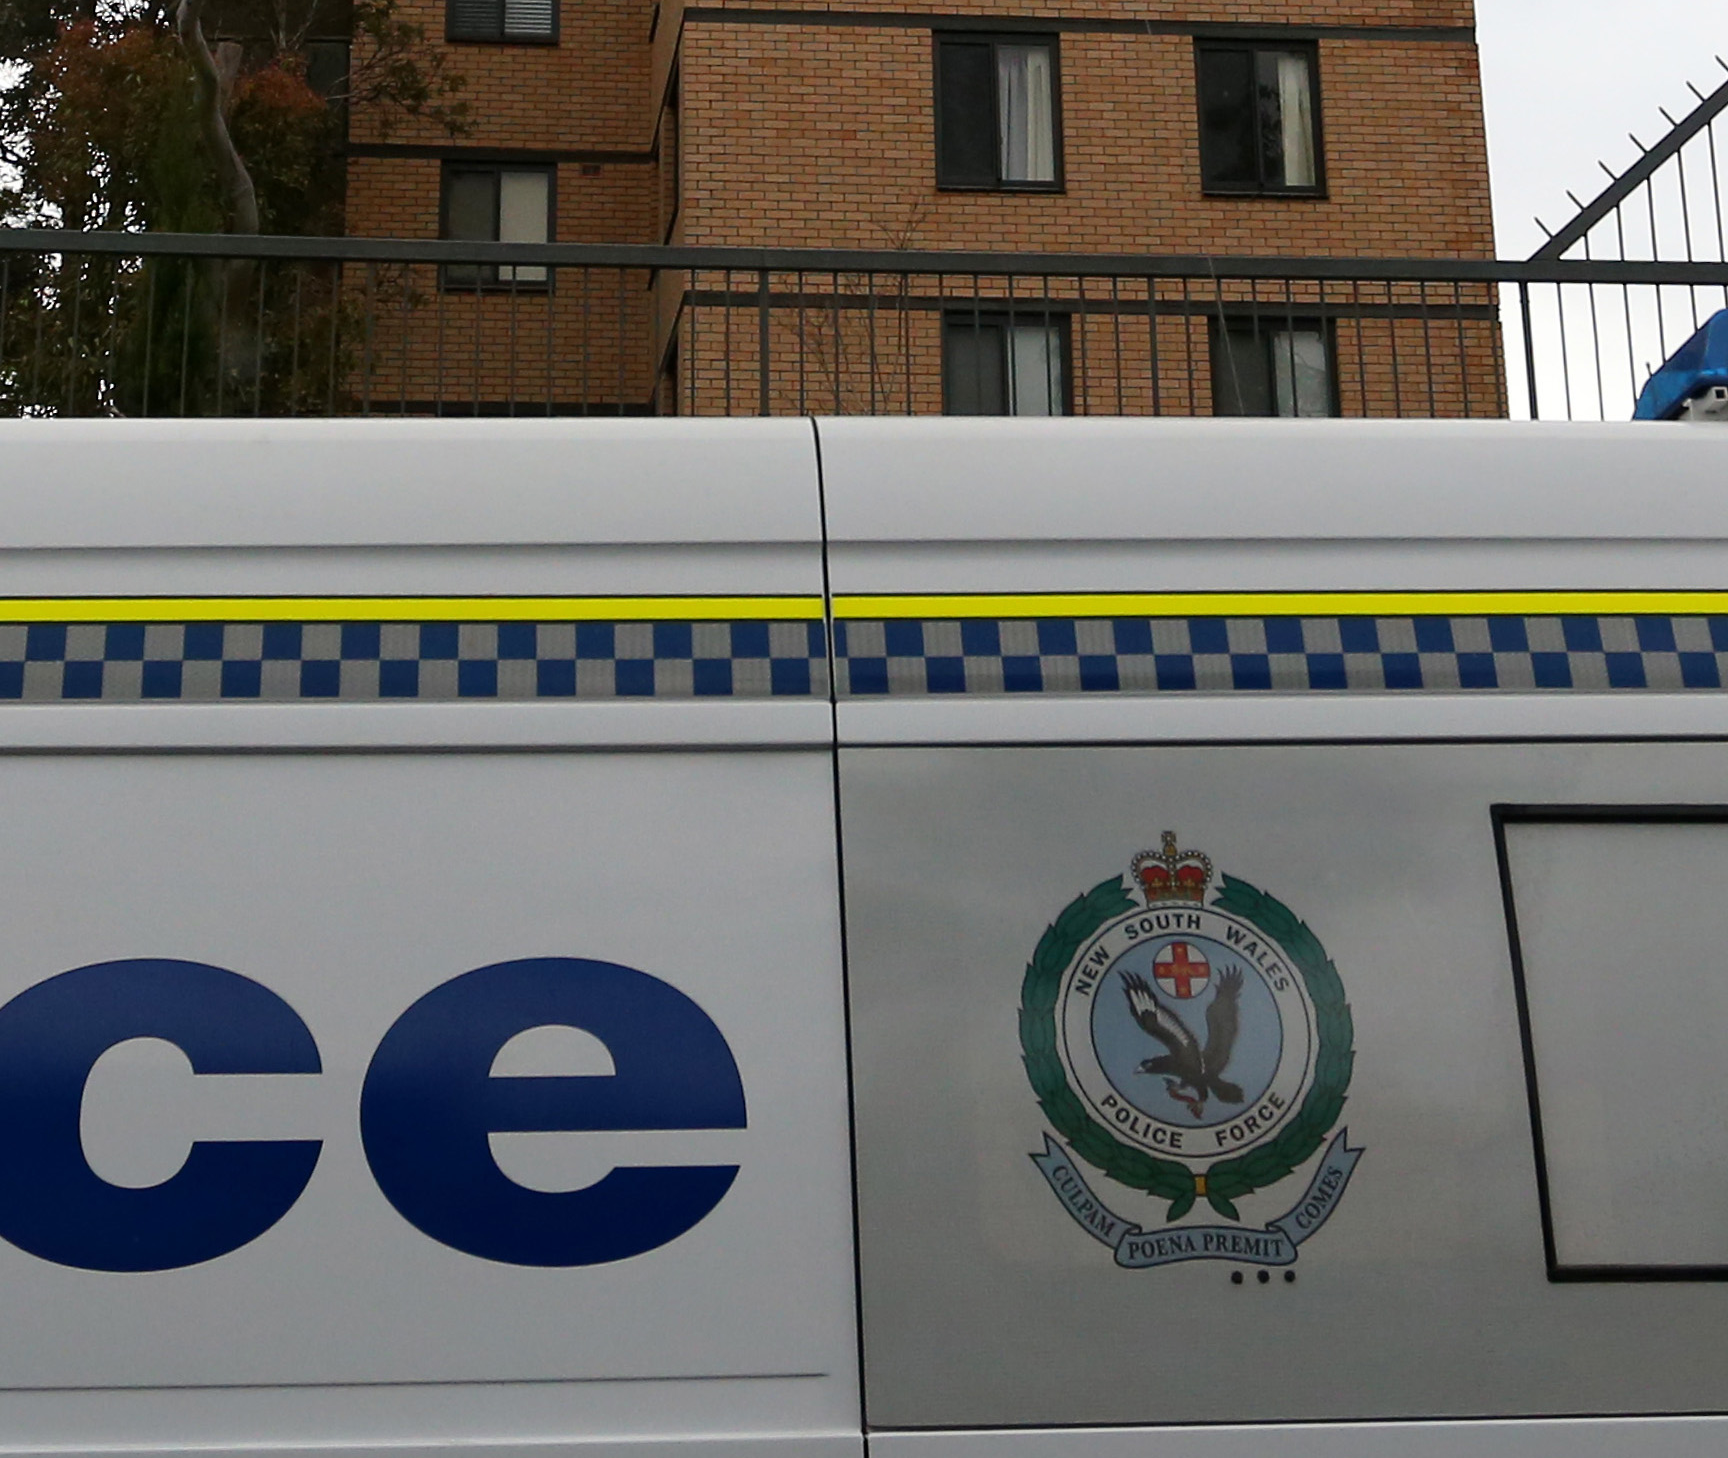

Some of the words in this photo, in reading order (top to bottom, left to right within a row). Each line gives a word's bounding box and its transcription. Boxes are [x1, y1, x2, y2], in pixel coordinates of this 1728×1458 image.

[1075, 945, 1111, 996] NEW
[1125, 913, 1202, 940] SOUTH
[1225, 925, 1290, 992] WALES
[1100, 1094, 1183, 1148] POLICE
[1215, 1092, 1285, 1146] FORCE
[1052, 1165, 1115, 1237] CULPAM
[1128, 1236, 1196, 1259] POENA
[1203, 1233, 1284, 1257] PREMIT
[1295, 1165, 1343, 1229] COMES
